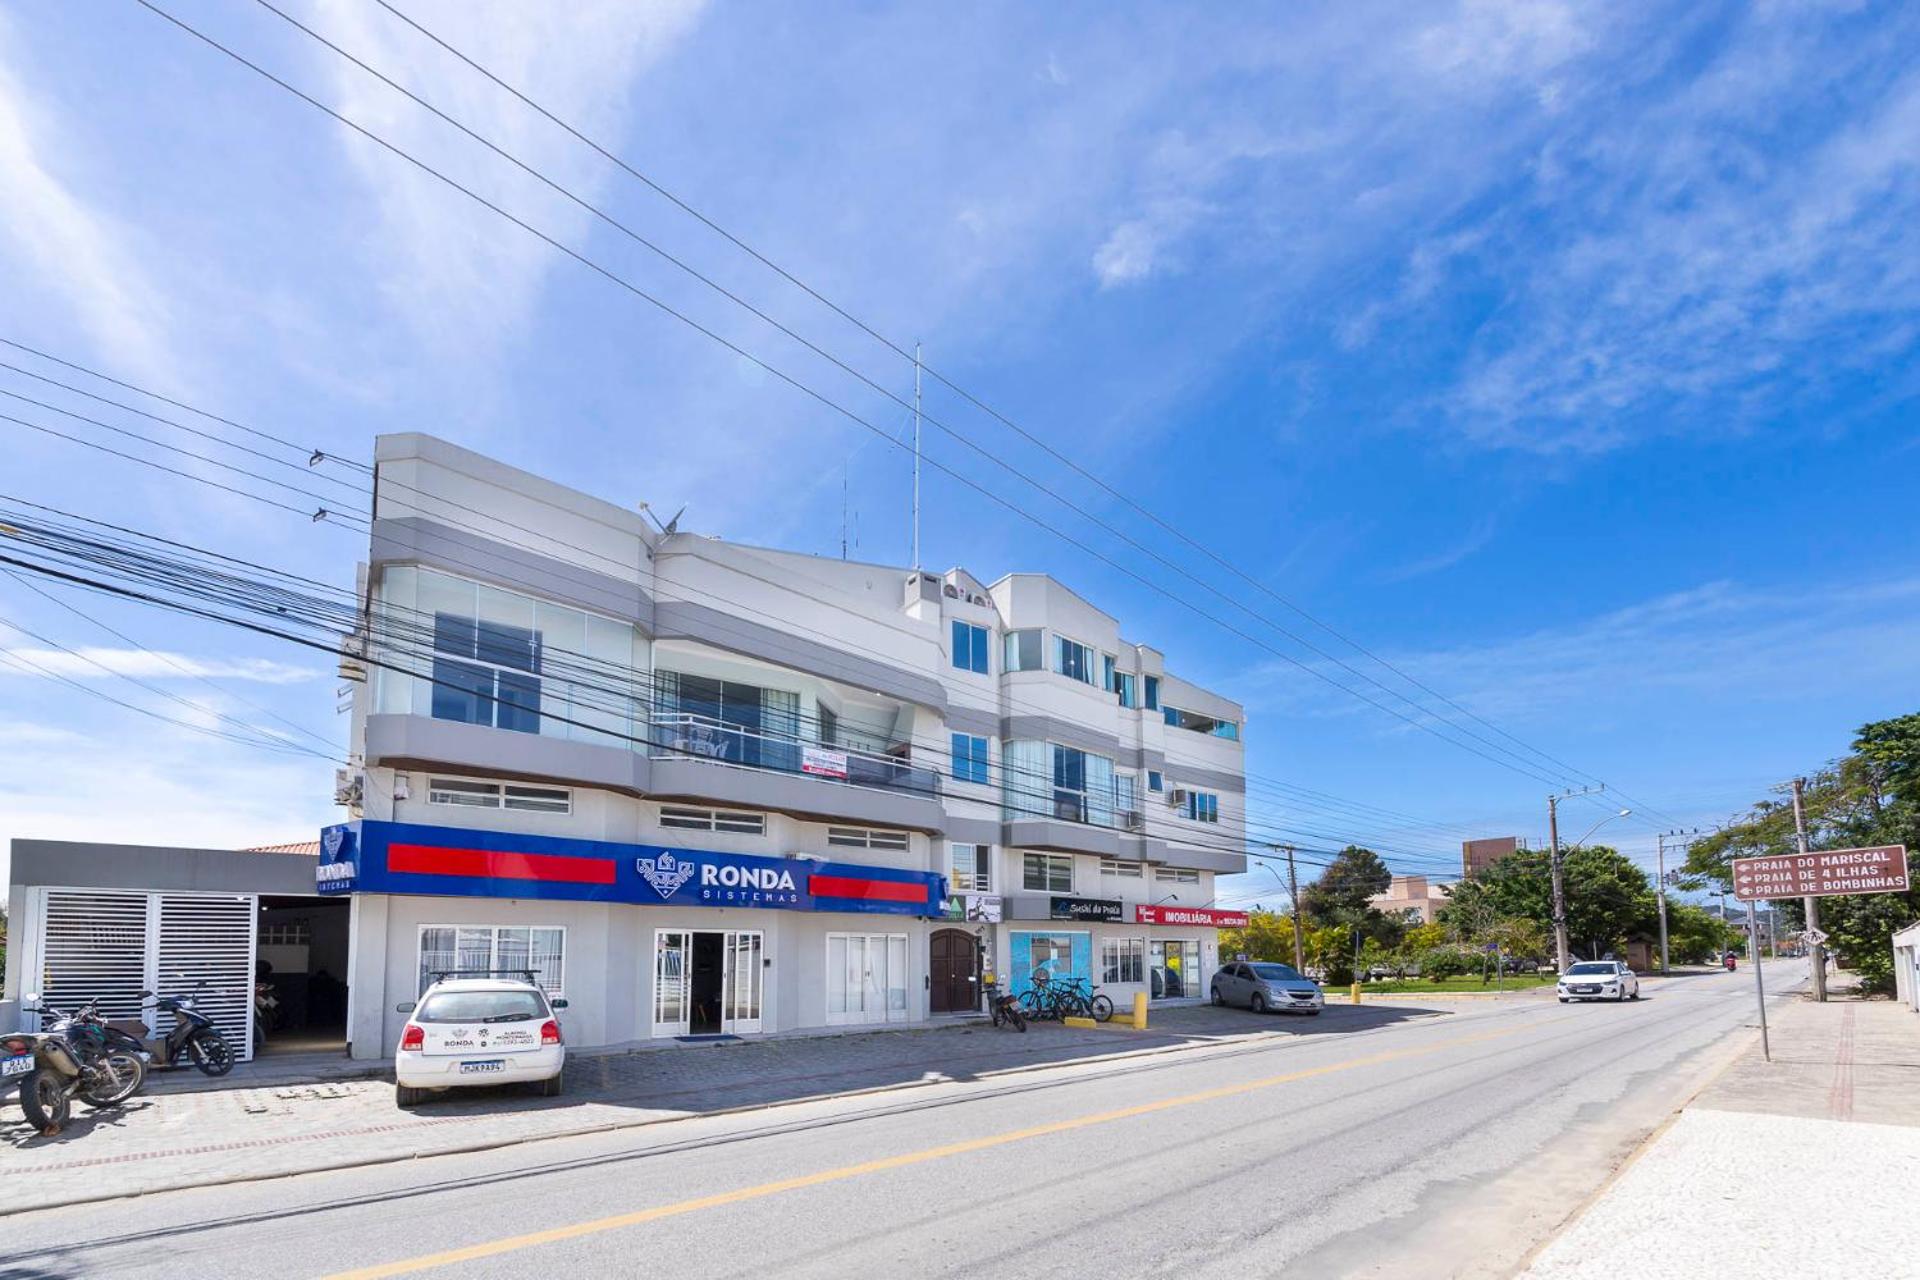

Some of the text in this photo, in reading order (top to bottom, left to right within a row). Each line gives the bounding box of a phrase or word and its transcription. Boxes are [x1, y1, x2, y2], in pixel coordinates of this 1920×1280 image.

[1753, 852, 1891, 871] PRAIA DO MARISCAL
[701, 864, 796, 890] RONDA
[1754, 865, 1878, 882] PRAIA DE 4 ILHAS
[1755, 876, 1905, 895] PRAIA DE BOMBINHAS
[703, 890, 797, 902] SISTEMAS
[1165, 911, 1213, 924] IMOBILIÁRIA
